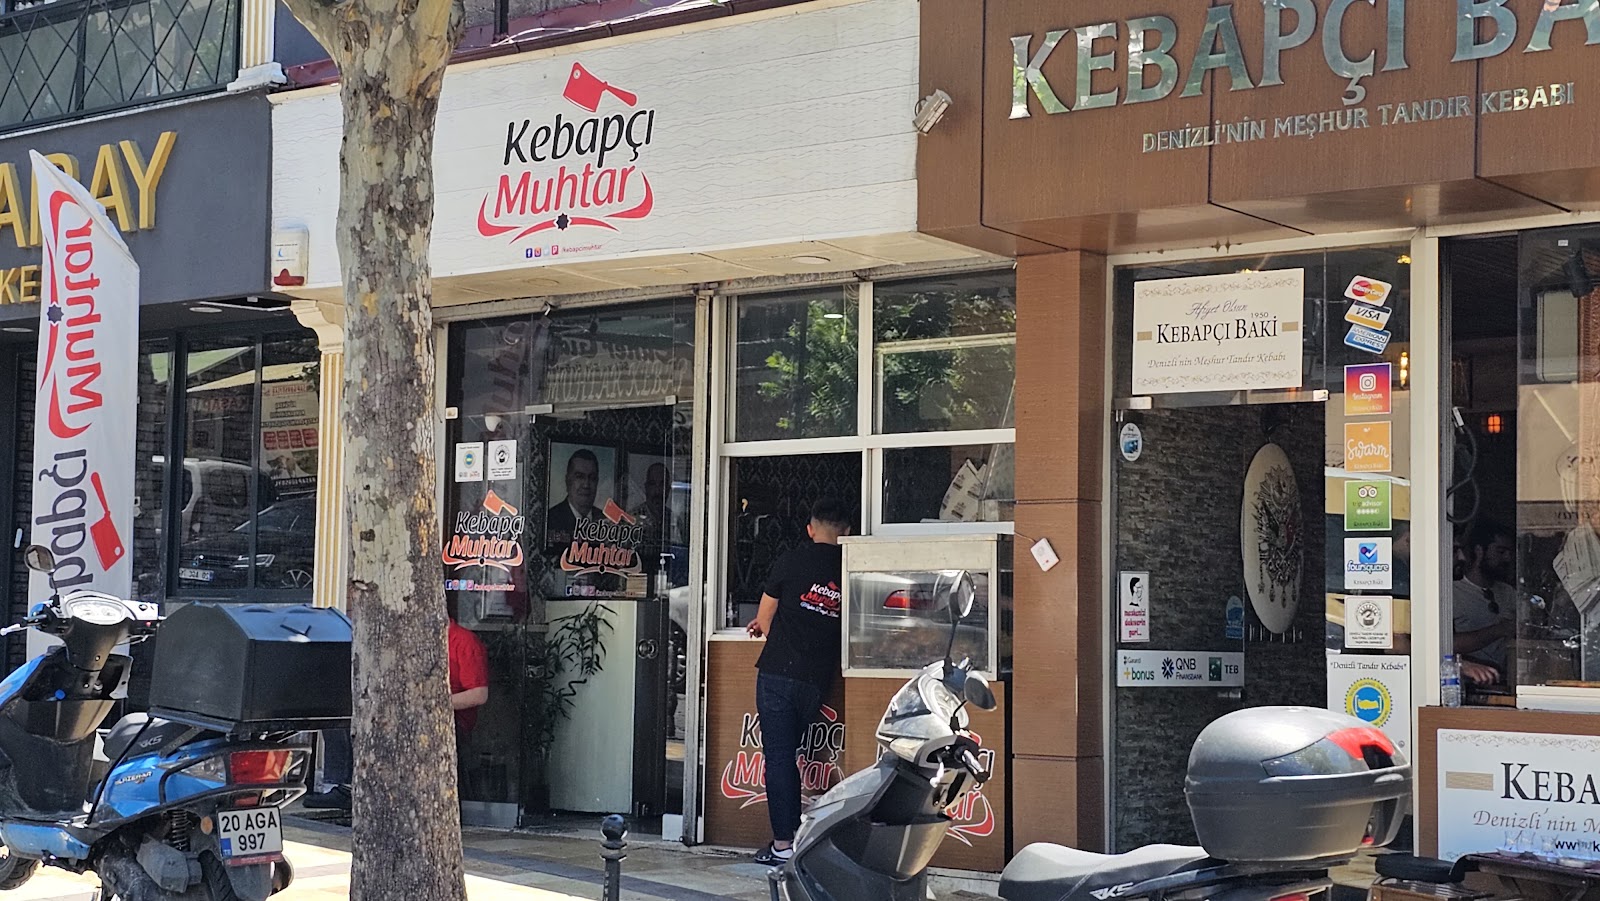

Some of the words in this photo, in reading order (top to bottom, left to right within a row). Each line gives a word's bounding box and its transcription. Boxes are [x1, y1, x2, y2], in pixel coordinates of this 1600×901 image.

[1009, 0, 1409, 119] KEBAPÇI
[1142, 116, 1266, 153] DENİZLİ'NİN
[1274, 106, 1370, 139] MEŞHUR
[1377, 95, 1473, 126] TANDIR
[1481, 82, 1575, 115] KEBABI
[503, 109, 655, 169] Kebapçı
[494, 163, 636, 218] Muhtar
[1356, 307, 1381, 321] VISA
[1347, 438, 1390, 460] Swarm
[454, 511, 525, 540] Kebapçı
[573, 517, 643, 548] Kebapçı
[449, 534, 515, 558] Muhtar
[568, 541, 636, 566] Muhtar
[1347, 560, 1389, 574] foursquare
[1131, 667, 1155, 680] bonus
[1175, 657, 1197, 670] QNB
[1224, 664, 1239, 674] TEB
[221, 813, 240, 833] 20
[245, 810, 278, 829] AGA
[238, 833, 266, 851] 997
[1089, 881, 1134, 900] RKS
